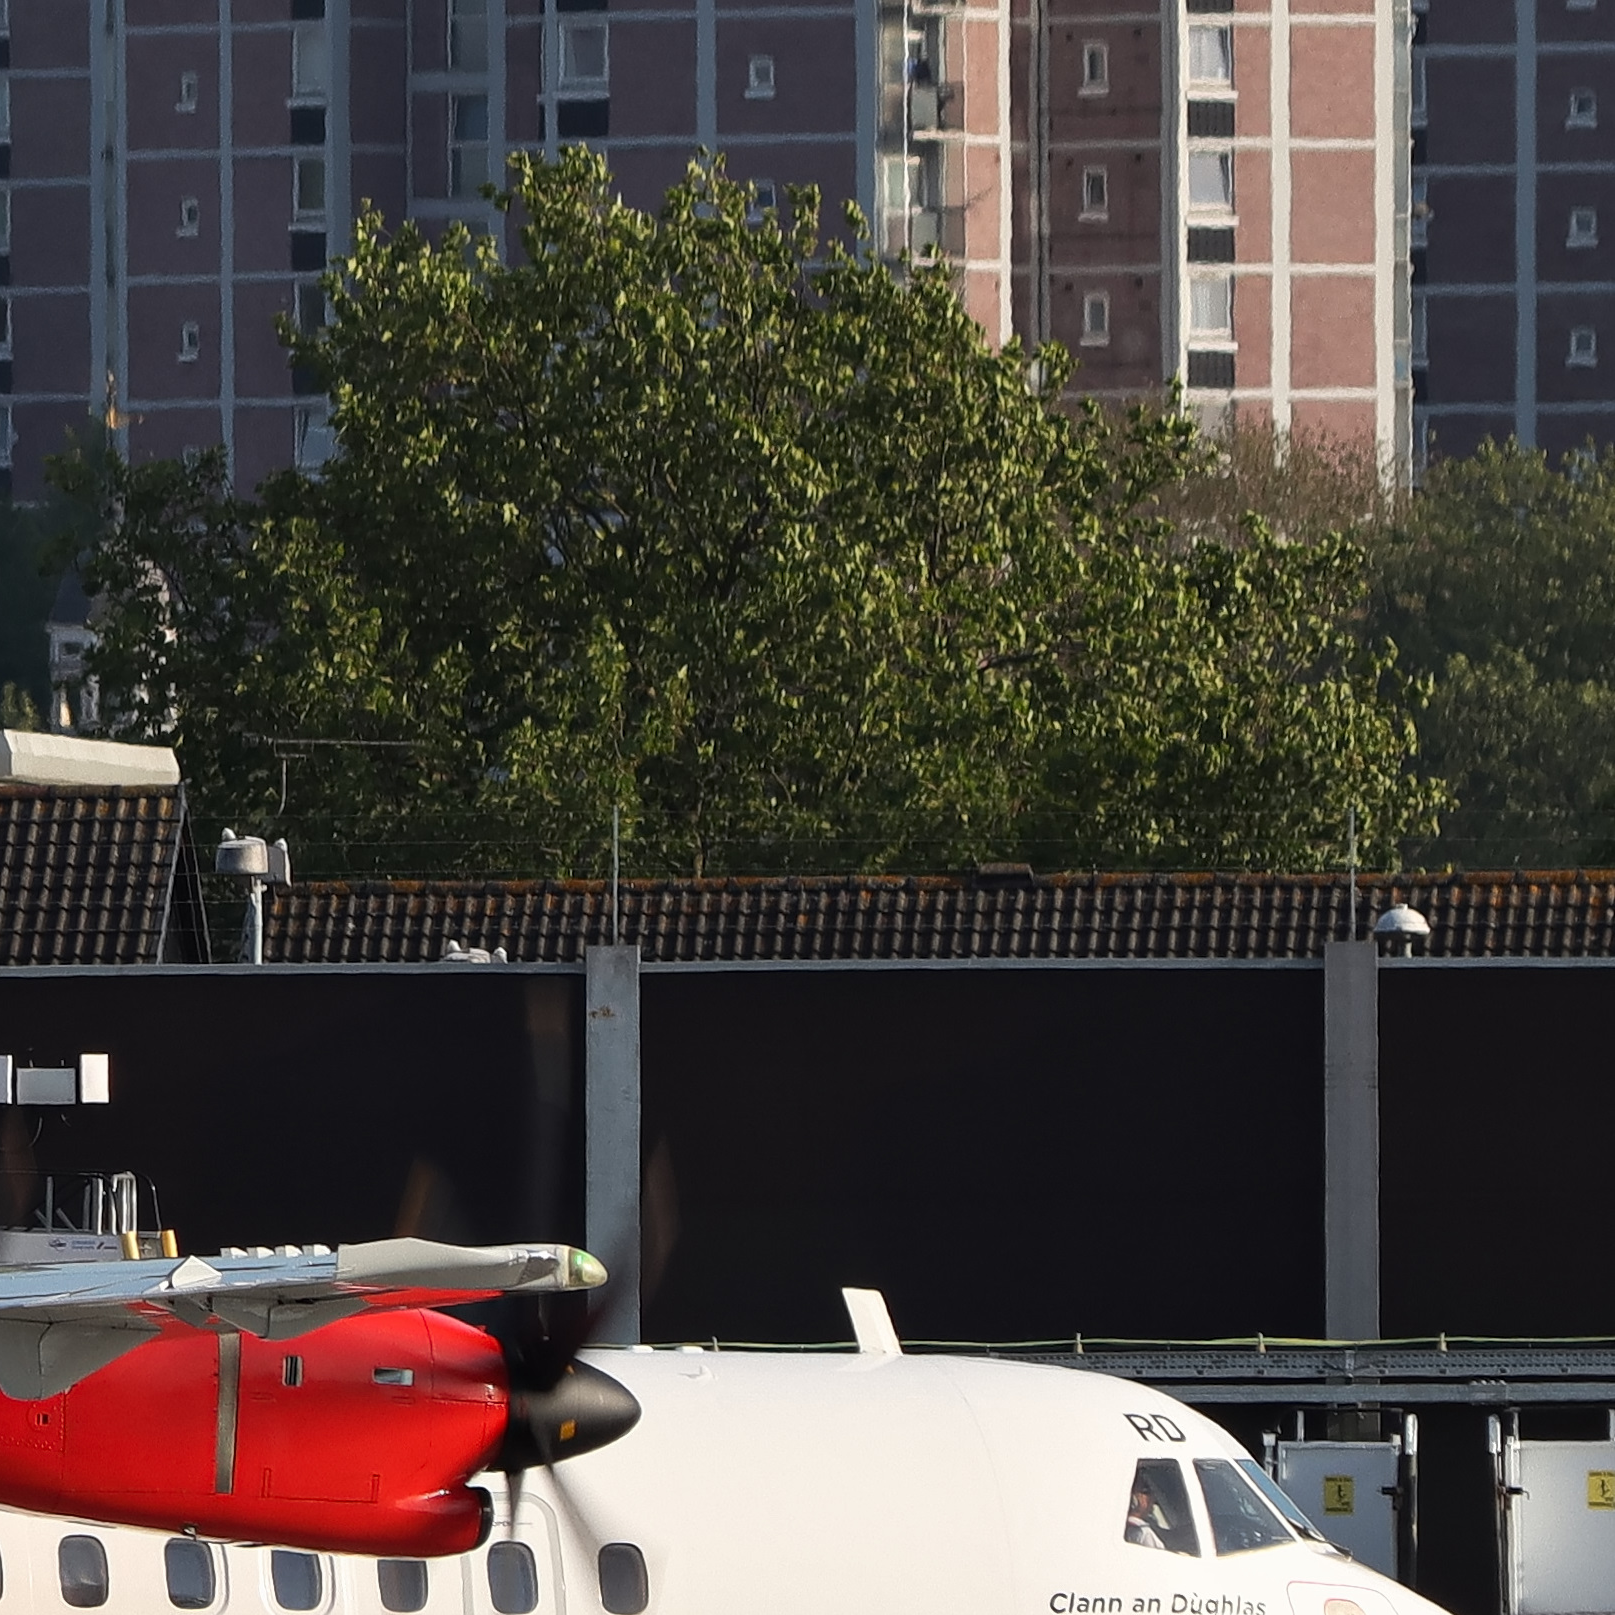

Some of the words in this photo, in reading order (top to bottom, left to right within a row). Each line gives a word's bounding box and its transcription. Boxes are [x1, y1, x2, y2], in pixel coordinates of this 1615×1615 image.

[1123, 1413, 1187, 1443] RD
[1049, 1592, 1122, 1614] Clann
[1132, 1597, 1161, 1614] an
